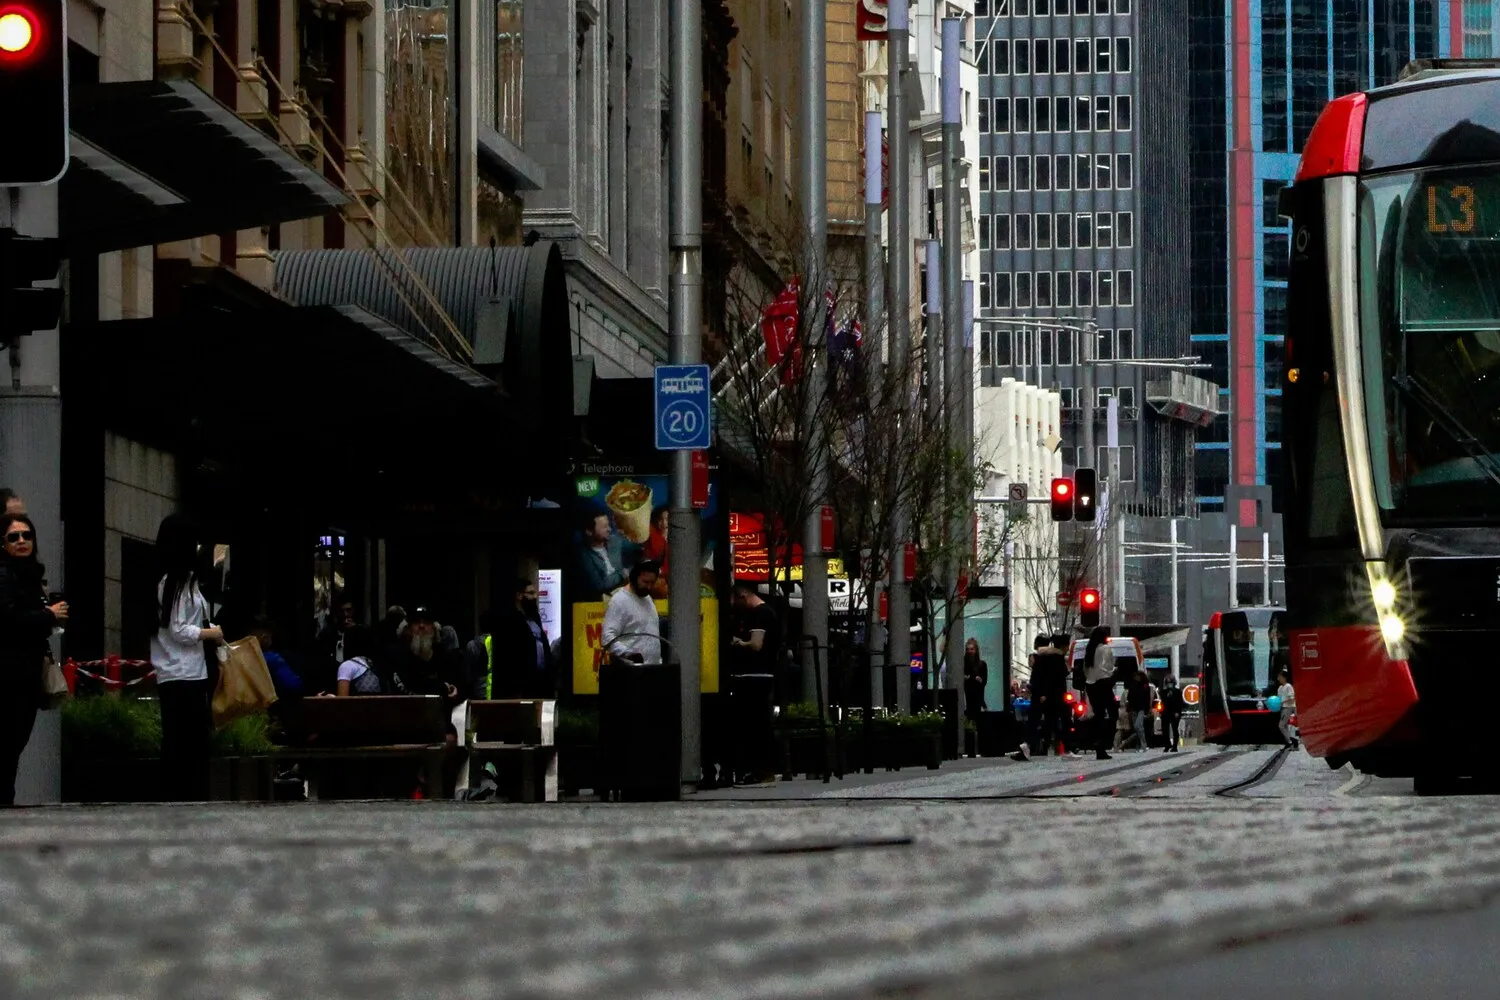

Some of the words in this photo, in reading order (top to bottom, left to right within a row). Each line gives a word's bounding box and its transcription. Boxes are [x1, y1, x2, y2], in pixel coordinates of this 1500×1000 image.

[1428, 185, 1475, 233] L3
[669, 410, 697, 432] 20
[581, 462, 634, 476] Telephone
[577, 479, 598, 492] NEW
